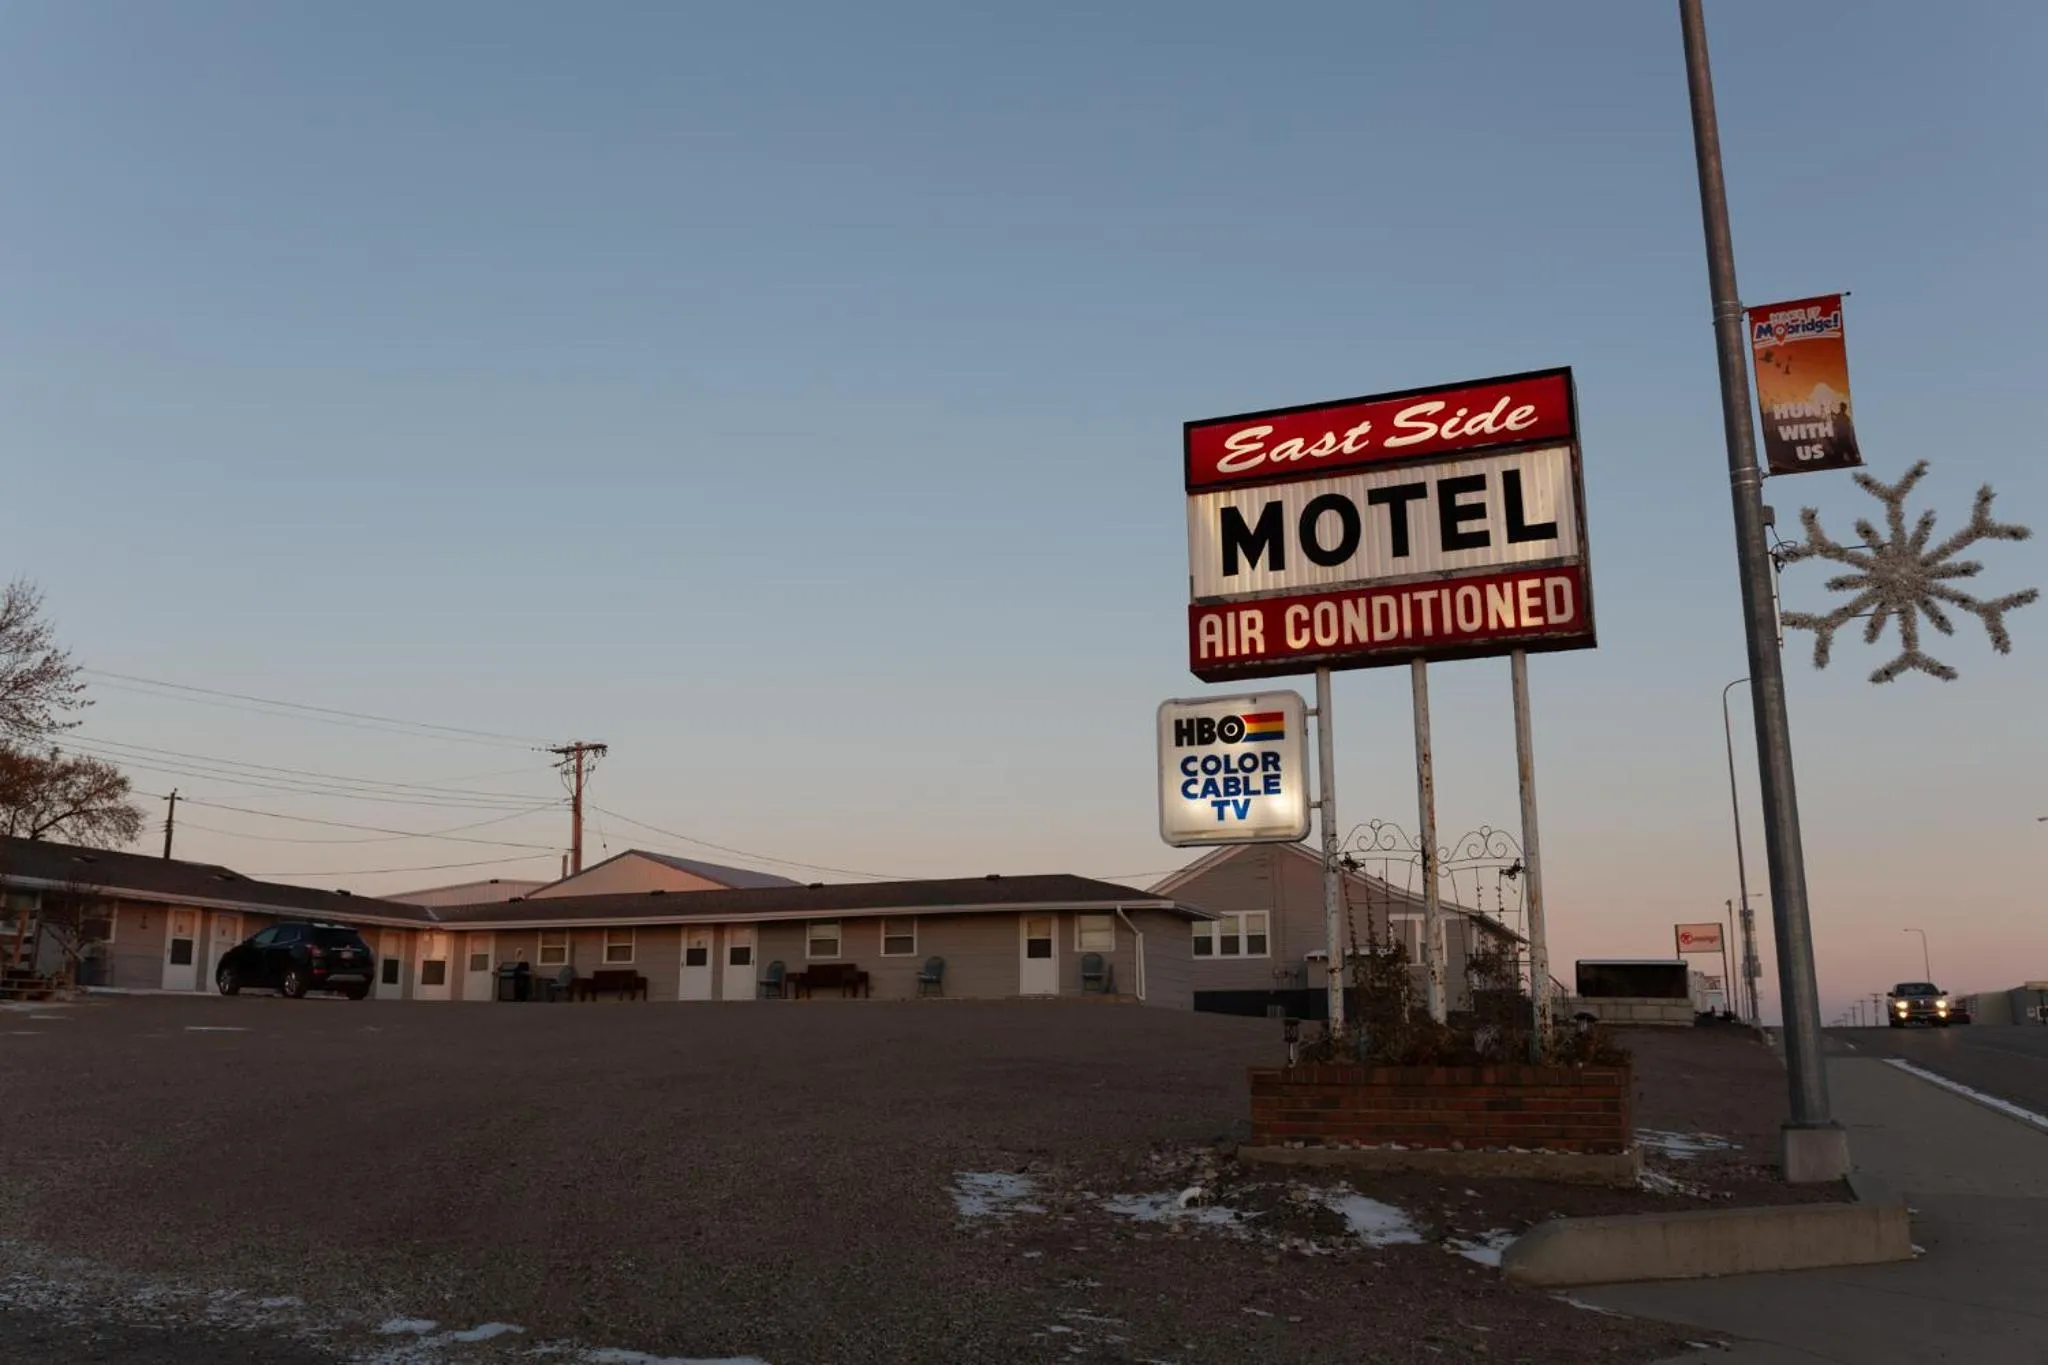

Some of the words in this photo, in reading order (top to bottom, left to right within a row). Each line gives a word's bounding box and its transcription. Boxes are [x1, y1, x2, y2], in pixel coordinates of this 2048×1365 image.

[1216, 419, 1375, 473] East
[1384, 396, 1539, 449] Side
[1777, 421, 1834, 441] WITH
[1795, 444, 1825, 460] US
[1220, 469, 1558, 577] MOTEL
[1200, 609, 1265, 659] AIR
[1284, 575, 1575, 650] CONDITIONED
[1174, 715, 1246, 747] HBO
[1180, 752, 1281, 777] COLOR
[1180, 774, 1281, 799] CABLE
[1211, 799, 1251, 821] TV
